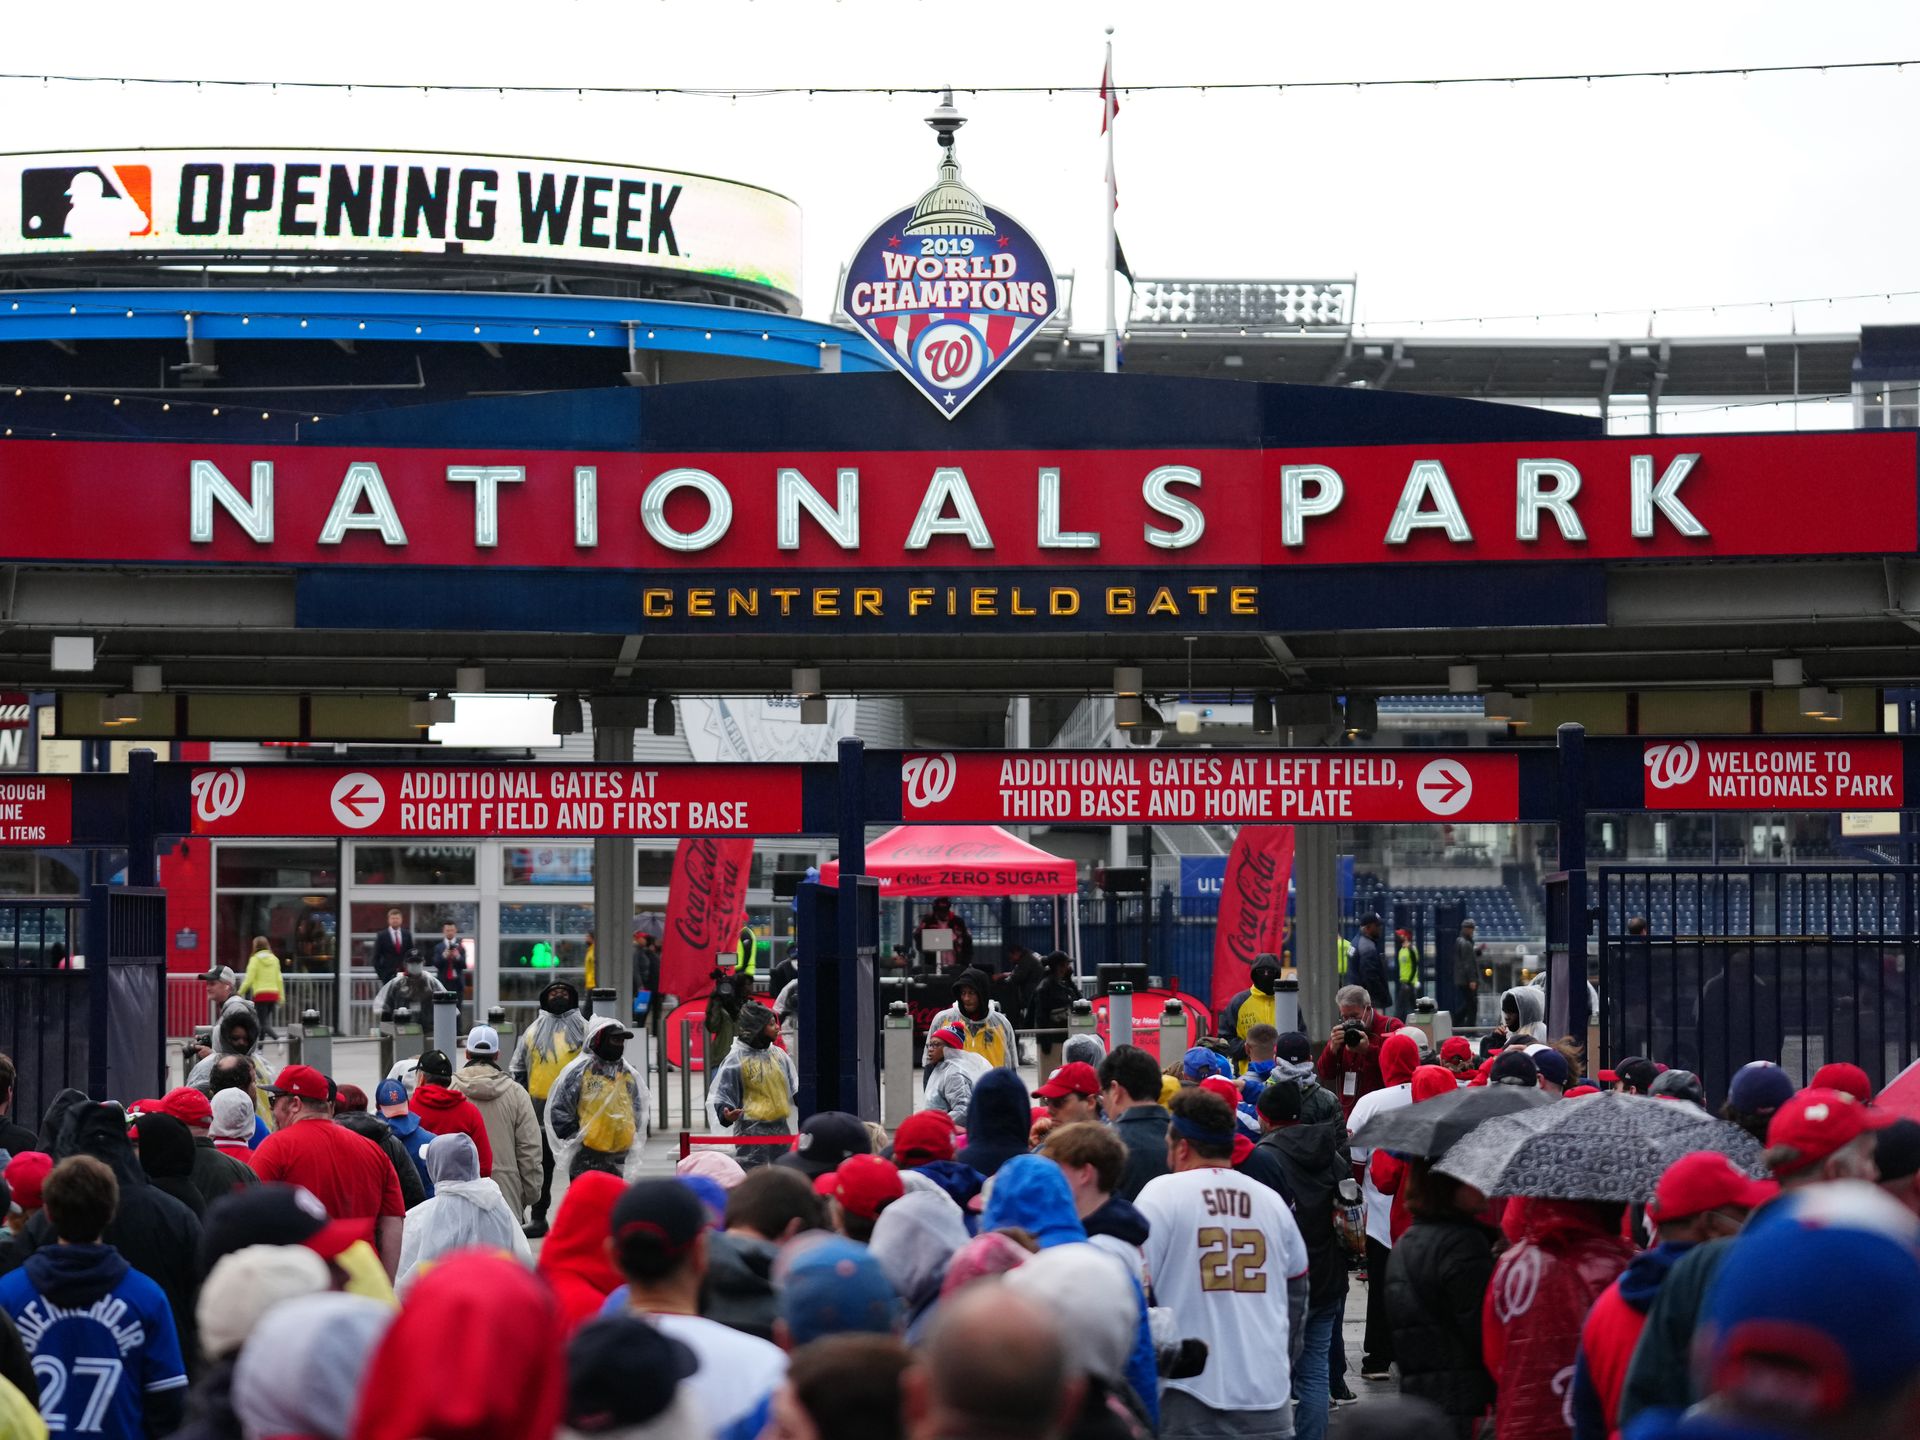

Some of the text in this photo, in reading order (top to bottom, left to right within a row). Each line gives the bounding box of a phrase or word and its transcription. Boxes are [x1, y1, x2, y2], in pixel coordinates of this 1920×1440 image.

[177, 163, 683, 256] OPENING WEEK
[920, 238, 975, 255] 2019
[882, 251, 1017, 280] WORLD
[851, 281, 1049, 316] CHAMPIONS
[925, 334, 973, 383] W
[190, 453, 1710, 552] NATIONALS PARK
[643, 586, 1259, 616] CENTER FIELD GATE
[1000, 758, 1404, 790] ADDITIONAL GATES AT LEFT FIELD,
[1707, 751, 1851, 773] WELCOME TO
[400, 771, 659, 799] ADDITIONAL GATES AT
[1708, 775, 1894, 797] NATIONALS PARK
[400, 801, 749, 830] RIGHT FIELD AND FIRST BASE
[999, 789, 1353, 817] THIRD BASE AND HOME PLATE
[10, 826, 46, 840] ITEMS
[939, 872, 990, 885] ZERO
[996, 871, 1060, 886] SUGAR
[1202, 1187, 1252, 1219] SOTO
[1198, 1227, 1267, 1293] 22
[31, 1354, 124, 1432] 27
